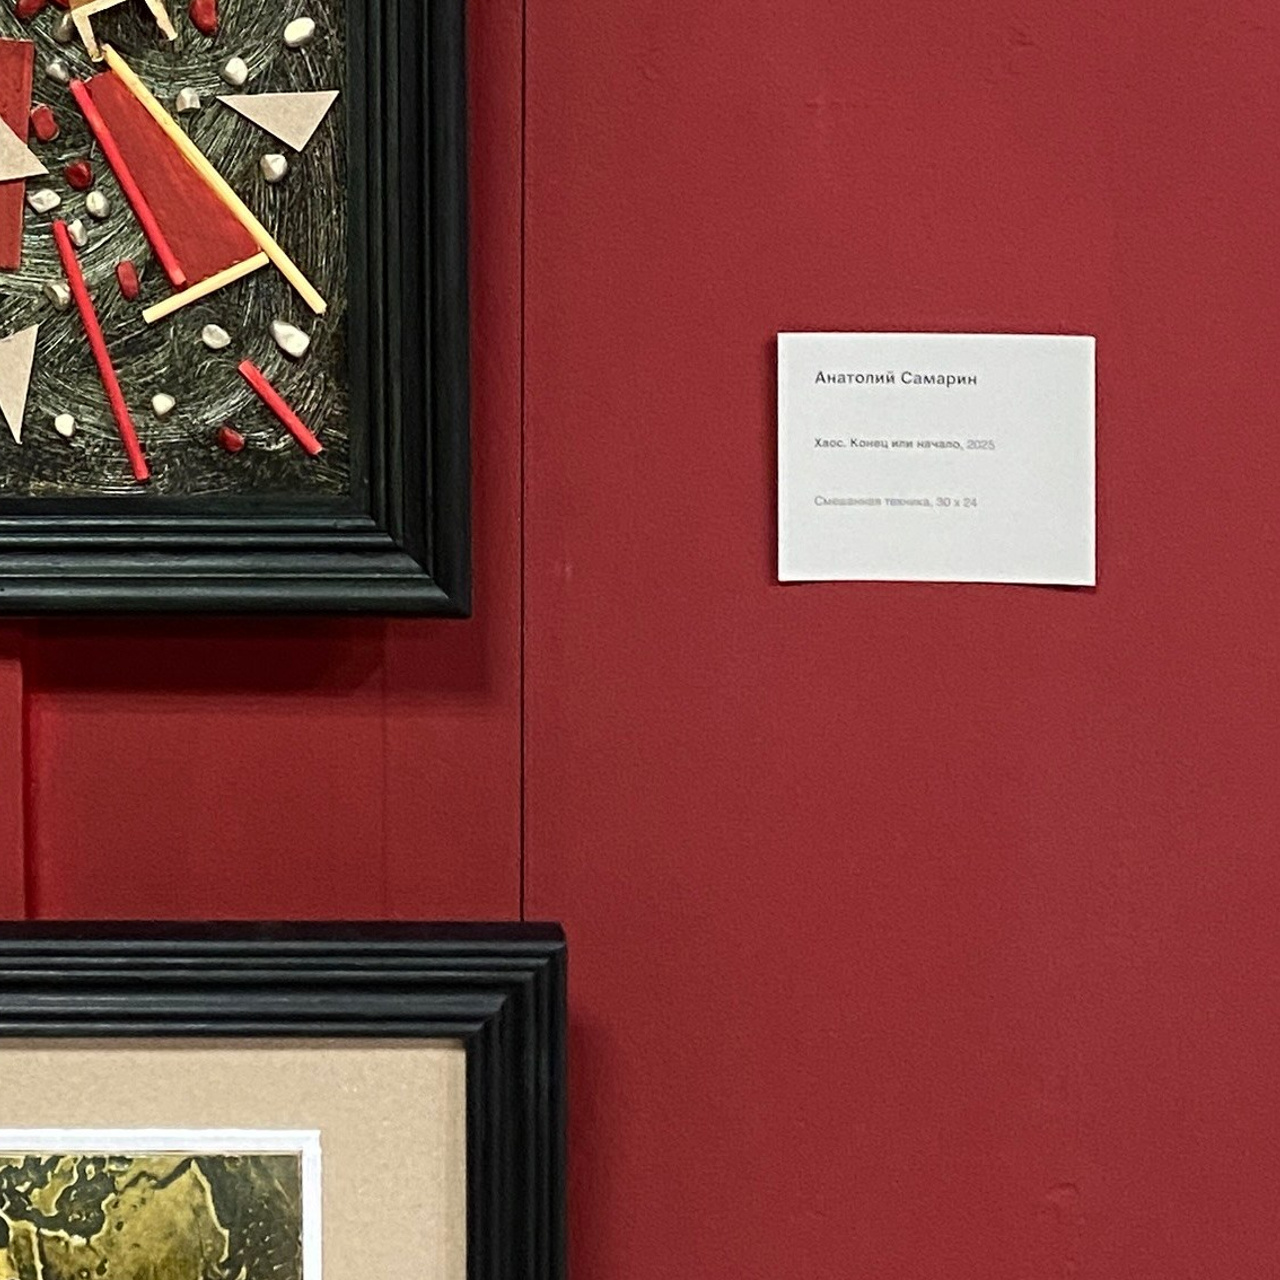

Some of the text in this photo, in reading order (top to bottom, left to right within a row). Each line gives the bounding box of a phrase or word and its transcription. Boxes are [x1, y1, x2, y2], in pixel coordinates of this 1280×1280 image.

[814, 370, 977, 388] Анатолий Самарин
[814, 438, 995, 450] Хаос. Конец или начало, 2025
[936, 497, 951, 507] 30
[963, 498, 977, 507] 24
